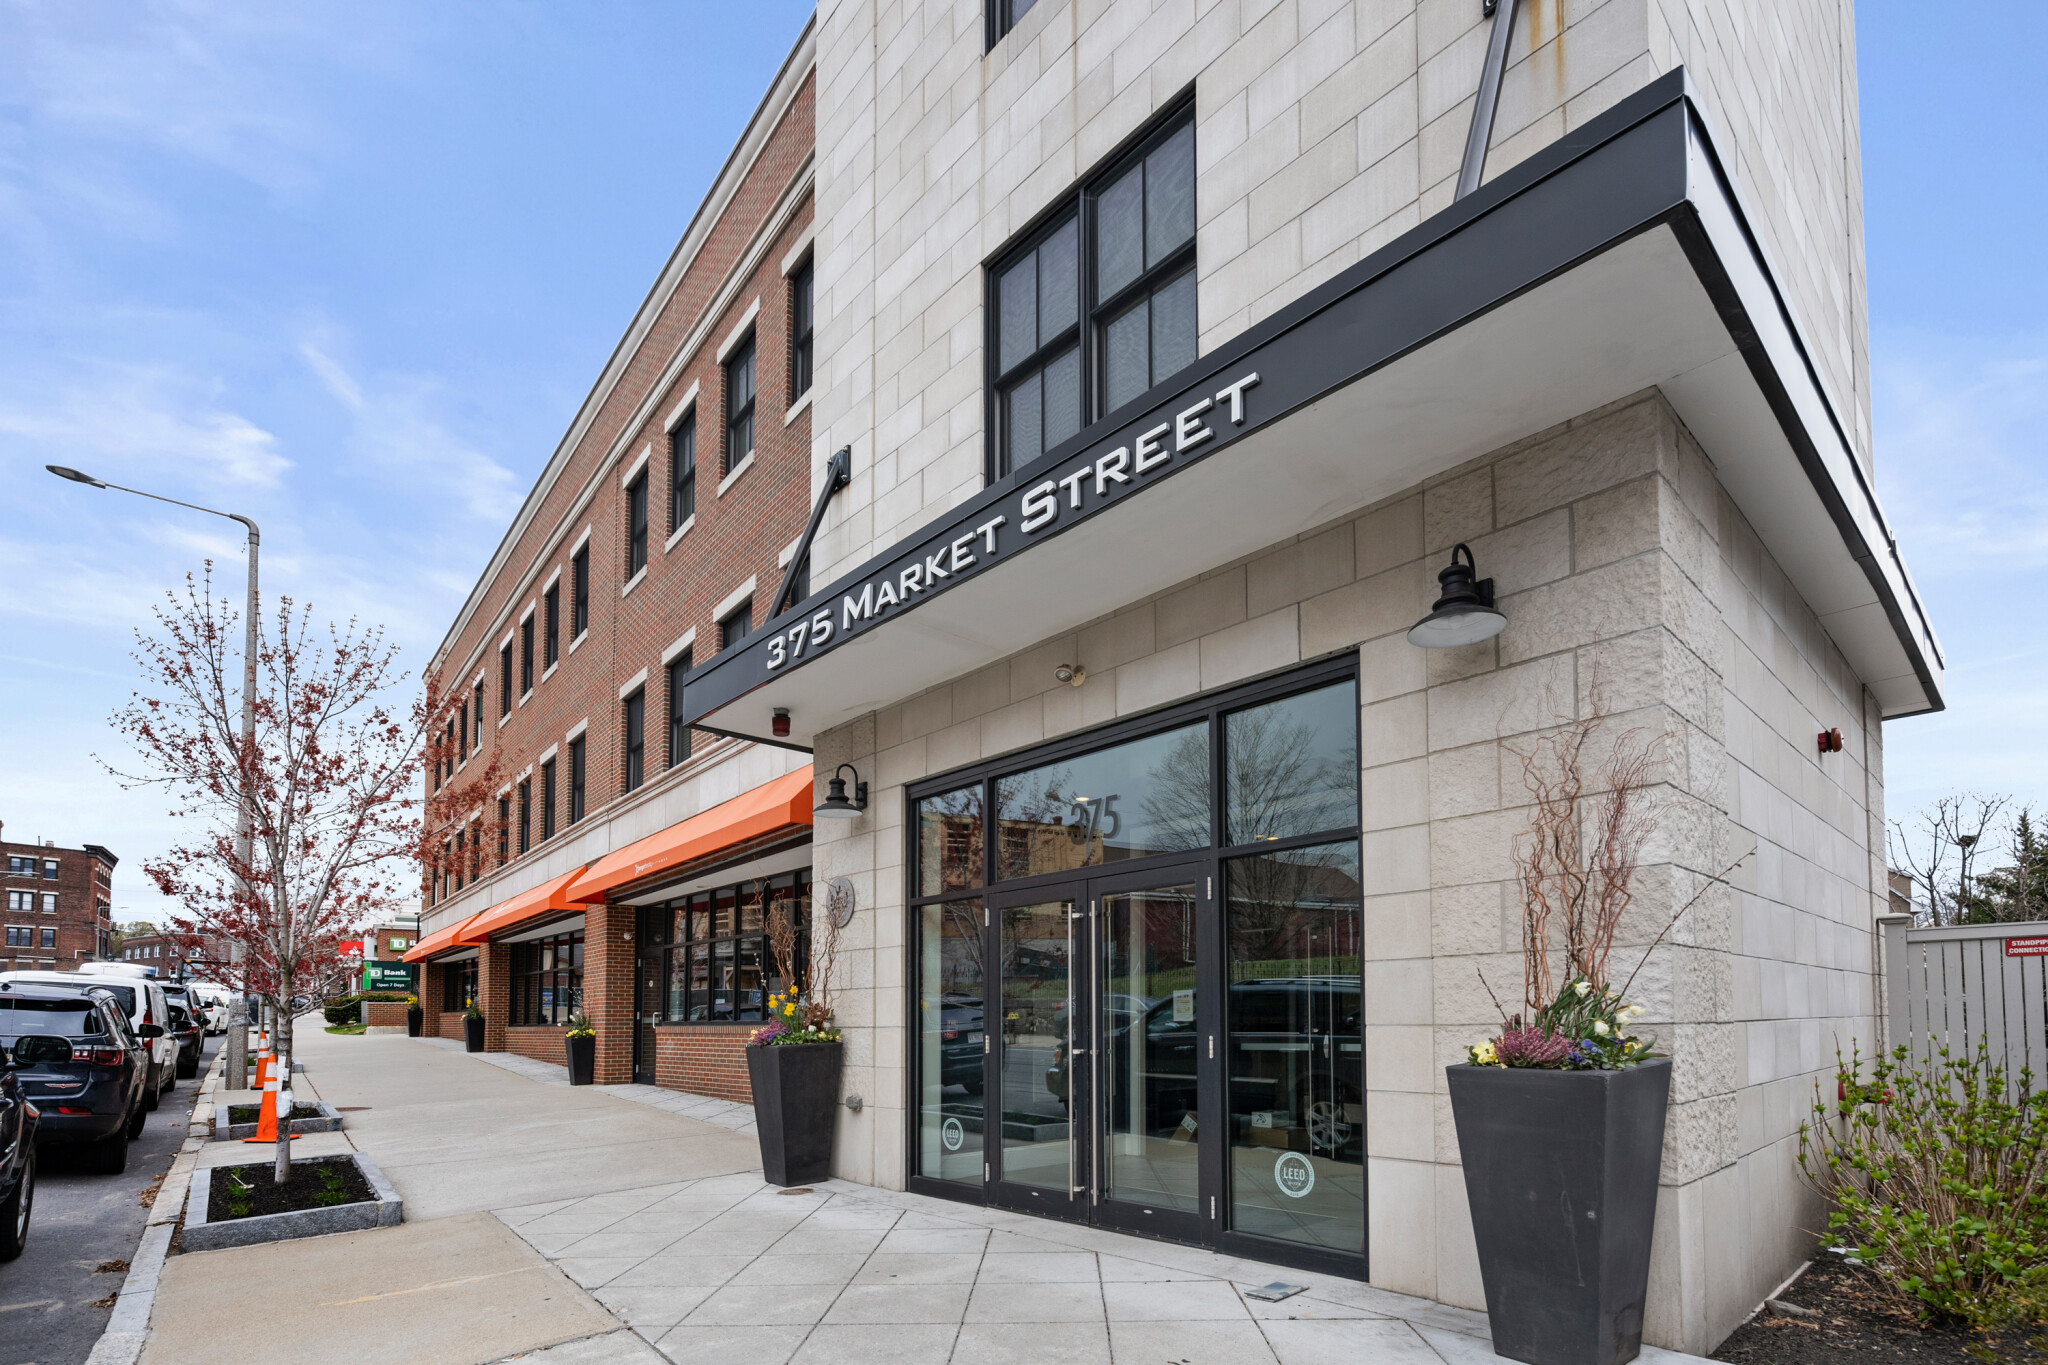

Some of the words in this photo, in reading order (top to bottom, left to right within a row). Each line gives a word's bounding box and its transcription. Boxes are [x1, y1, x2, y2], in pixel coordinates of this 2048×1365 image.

[767, 608, 834, 670] 375
[842, 513, 1006, 630] MARKET
[1021, 371, 1260, 534] STREET
[1071, 794, 1119, 845] 375
[391, 939, 405, 948] TD
[947, 1129, 959, 1138] LEED
[1283, 1167, 1305, 1181] LEED
